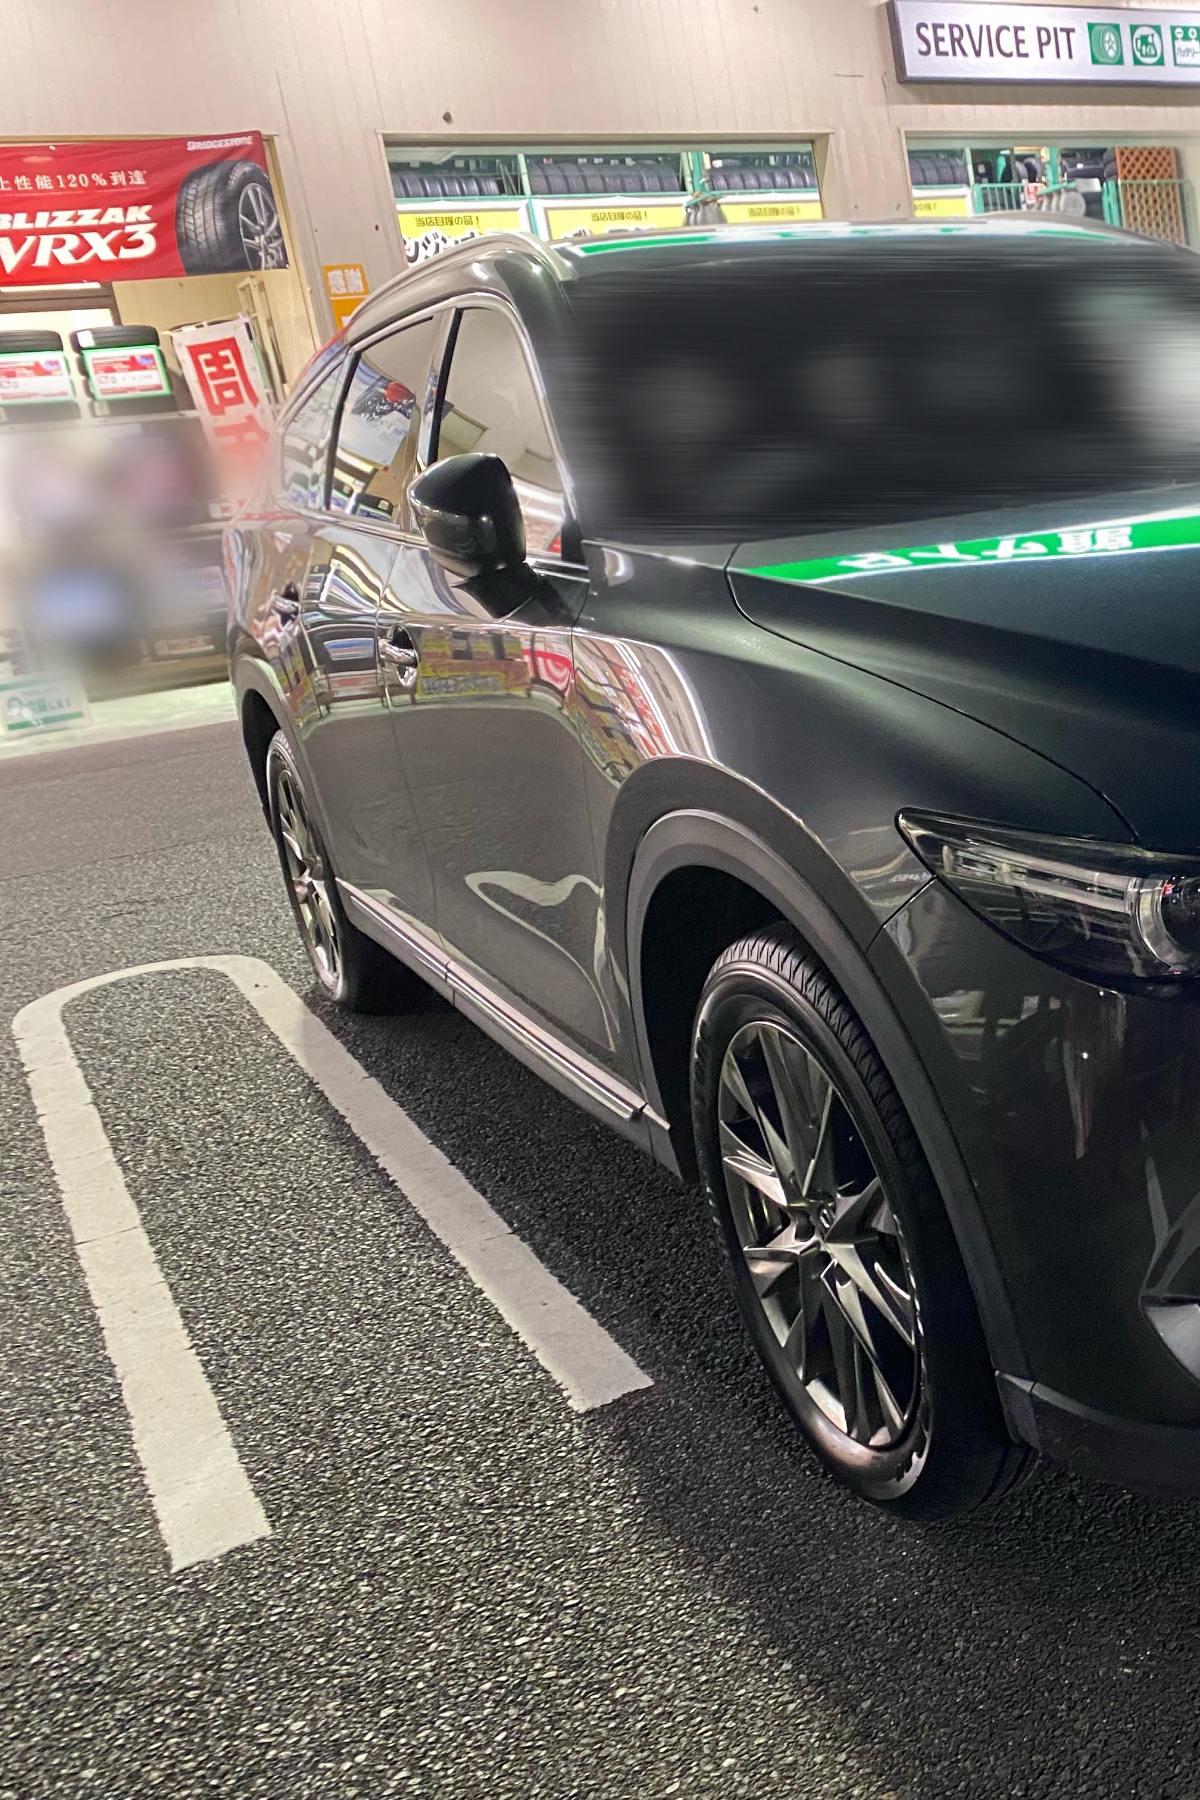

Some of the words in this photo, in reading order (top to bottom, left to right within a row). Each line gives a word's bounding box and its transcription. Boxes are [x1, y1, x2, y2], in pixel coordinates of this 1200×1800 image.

[915, 21, 1030, 59] SERVICE
[1036, 26, 1076, 60] PIT
[186, 135, 253, 151] BRIDGESTONE
[0, 204, 153, 230] BLIZZAK
[0, 222, 158, 275] VRX3
